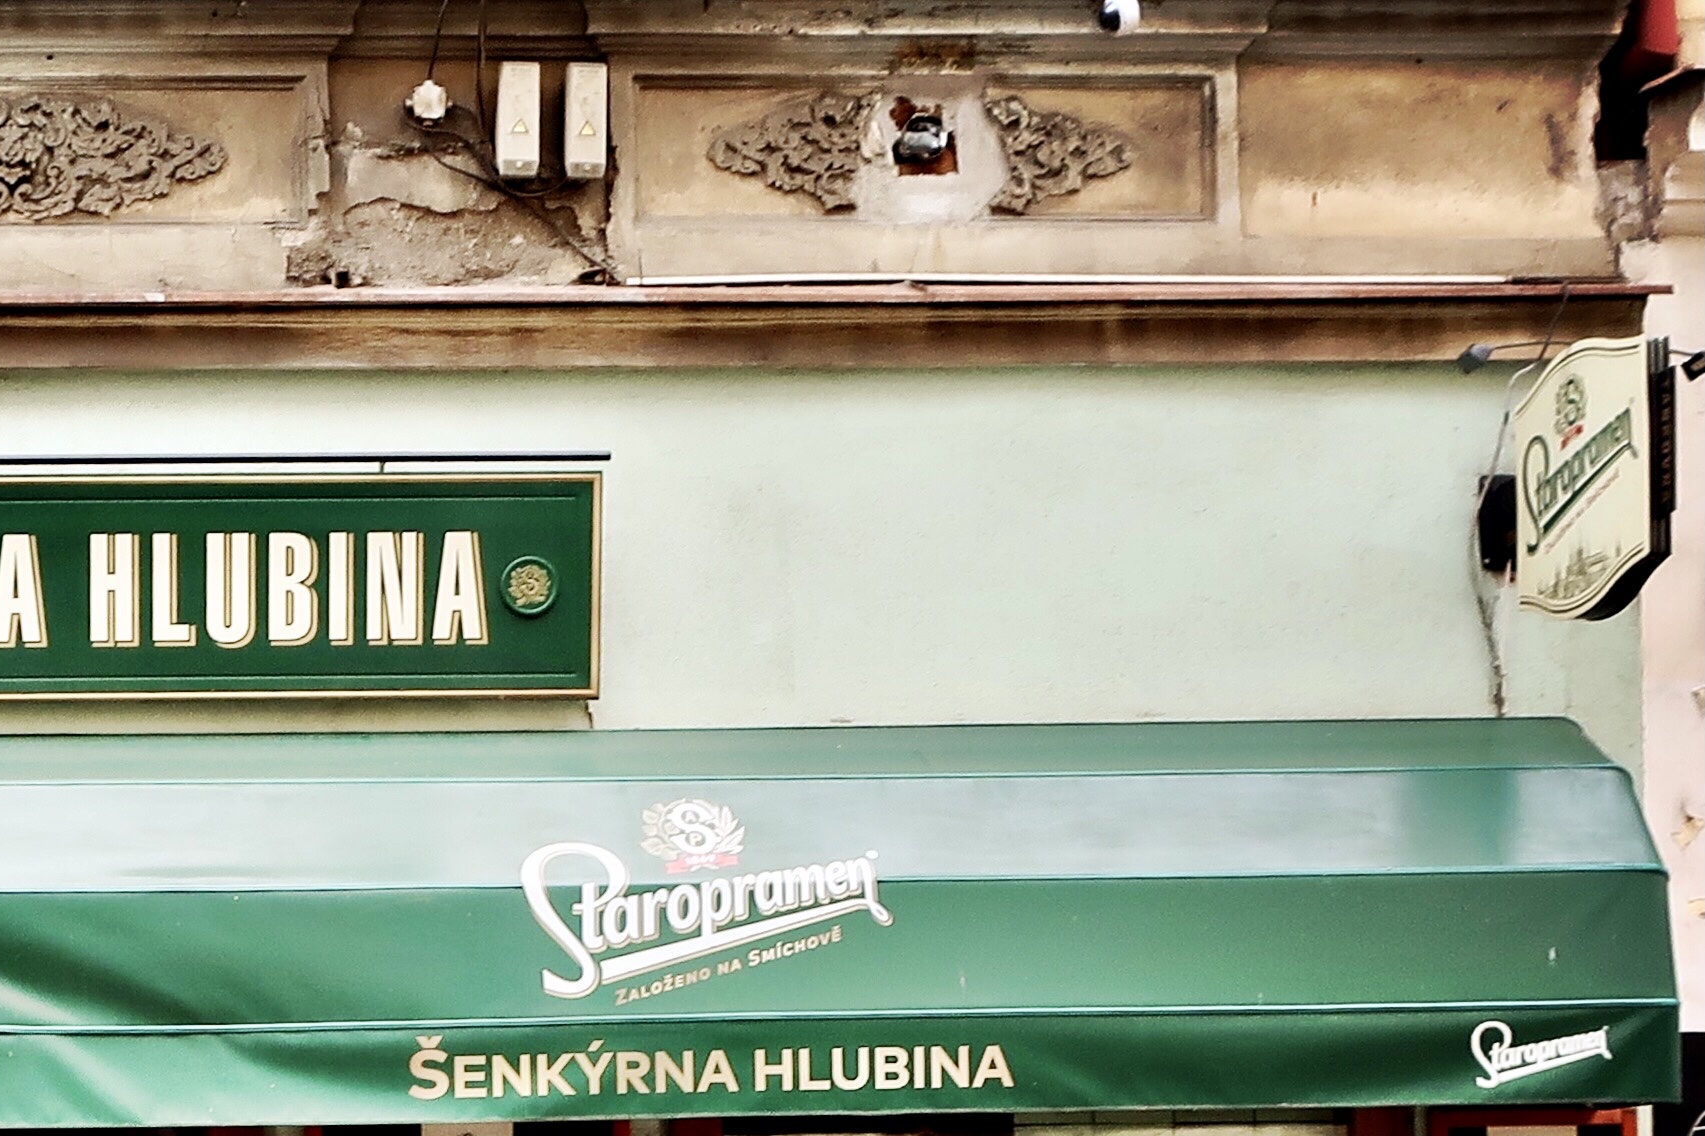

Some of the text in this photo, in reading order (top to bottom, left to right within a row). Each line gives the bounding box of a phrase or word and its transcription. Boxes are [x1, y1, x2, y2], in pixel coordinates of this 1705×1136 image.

[88, 530, 491, 649] HLUBINA
[520, 841, 894, 999] Staropramen
[614, 967, 712, 1007] ZALOŽENO
[716, 957, 742, 976] NA
[408, 1035, 1015, 1099] ŠENKÝRNA HLUBINA
[1470, 1020, 1613, 1089] Staropramen
